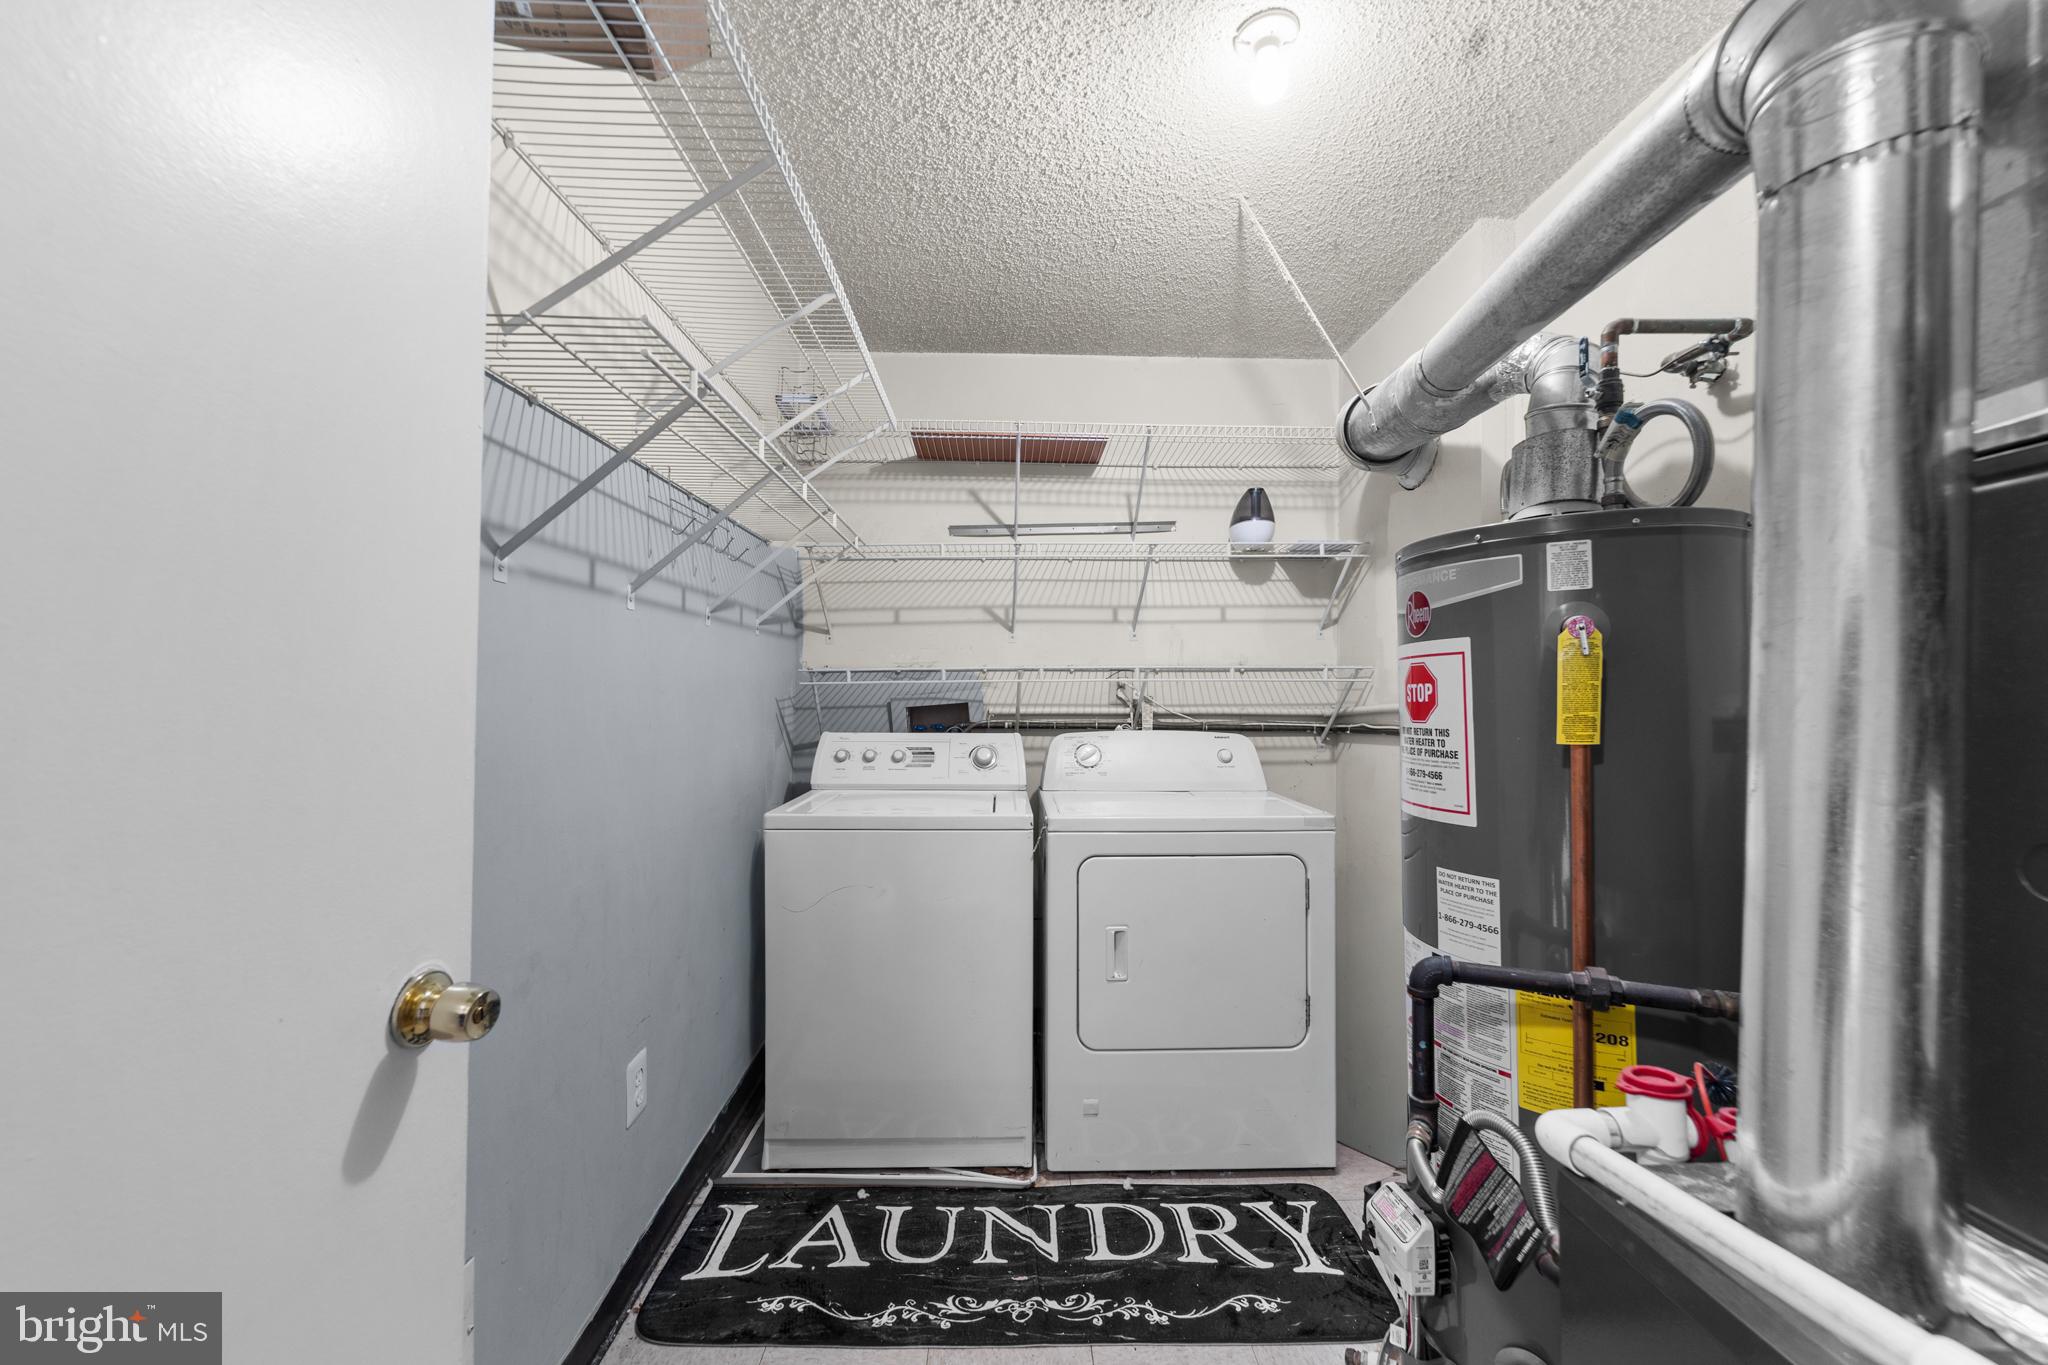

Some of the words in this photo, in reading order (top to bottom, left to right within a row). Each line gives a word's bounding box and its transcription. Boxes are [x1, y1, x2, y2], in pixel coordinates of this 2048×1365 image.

[1407, 593, 1430, 630] Rheem
[1407, 683, 1433, 703] STOP
[1413, 728, 1433, 737] RETURN
[1434, 728, 1450, 738] THIS
[1415, 738, 1436, 748] HEATER
[1436, 739, 1446, 748] TO
[1416, 747, 1423, 757] OF
[1424, 749, 1459, 760] PURCHASE
[1438, 879, 1454, 887] WATER
[1454, 883, 1475, 892] HEATER
[1485, 889, 1497, 897] THE
[1458, 876, 1480, 885] RETURN
[1481, 881, 1496, 889] THIS
[1440, 888, 1454, 896] PLACE
[1463, 893, 1495, 905] PURCHASE
[1438, 911, 1500, 935] 1-866-279-4566
[680, 1201, 1344, 1280] LAUNDRY
